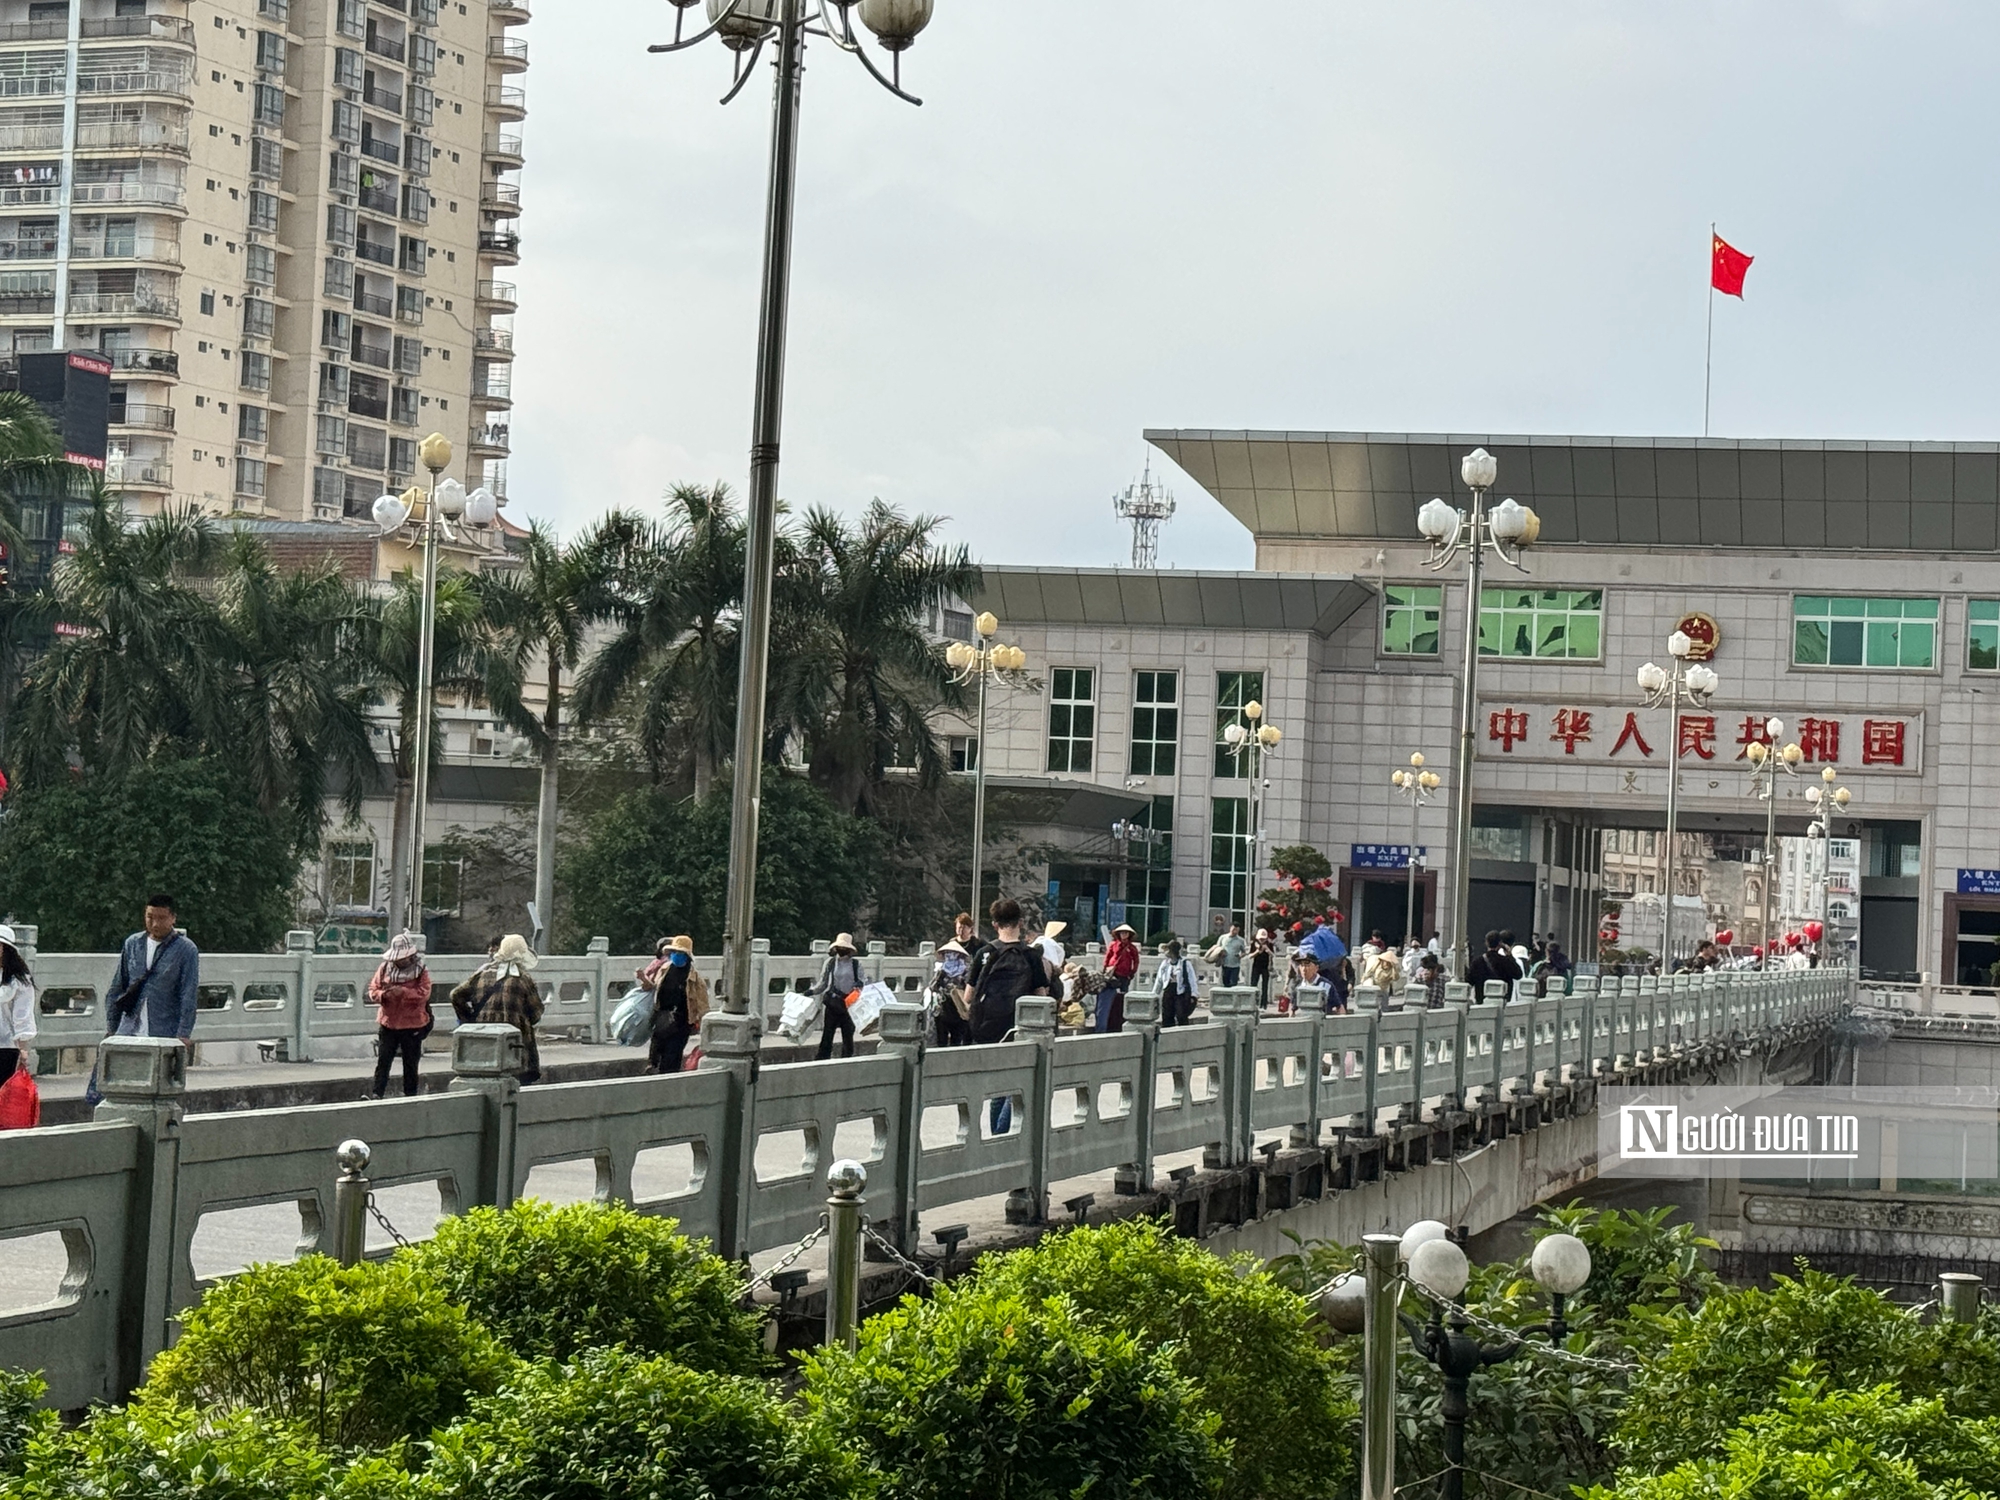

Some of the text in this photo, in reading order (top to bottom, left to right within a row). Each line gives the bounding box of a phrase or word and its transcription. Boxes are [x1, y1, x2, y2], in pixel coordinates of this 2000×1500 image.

[1489, 706, 1906, 766] 中华人民共和国
